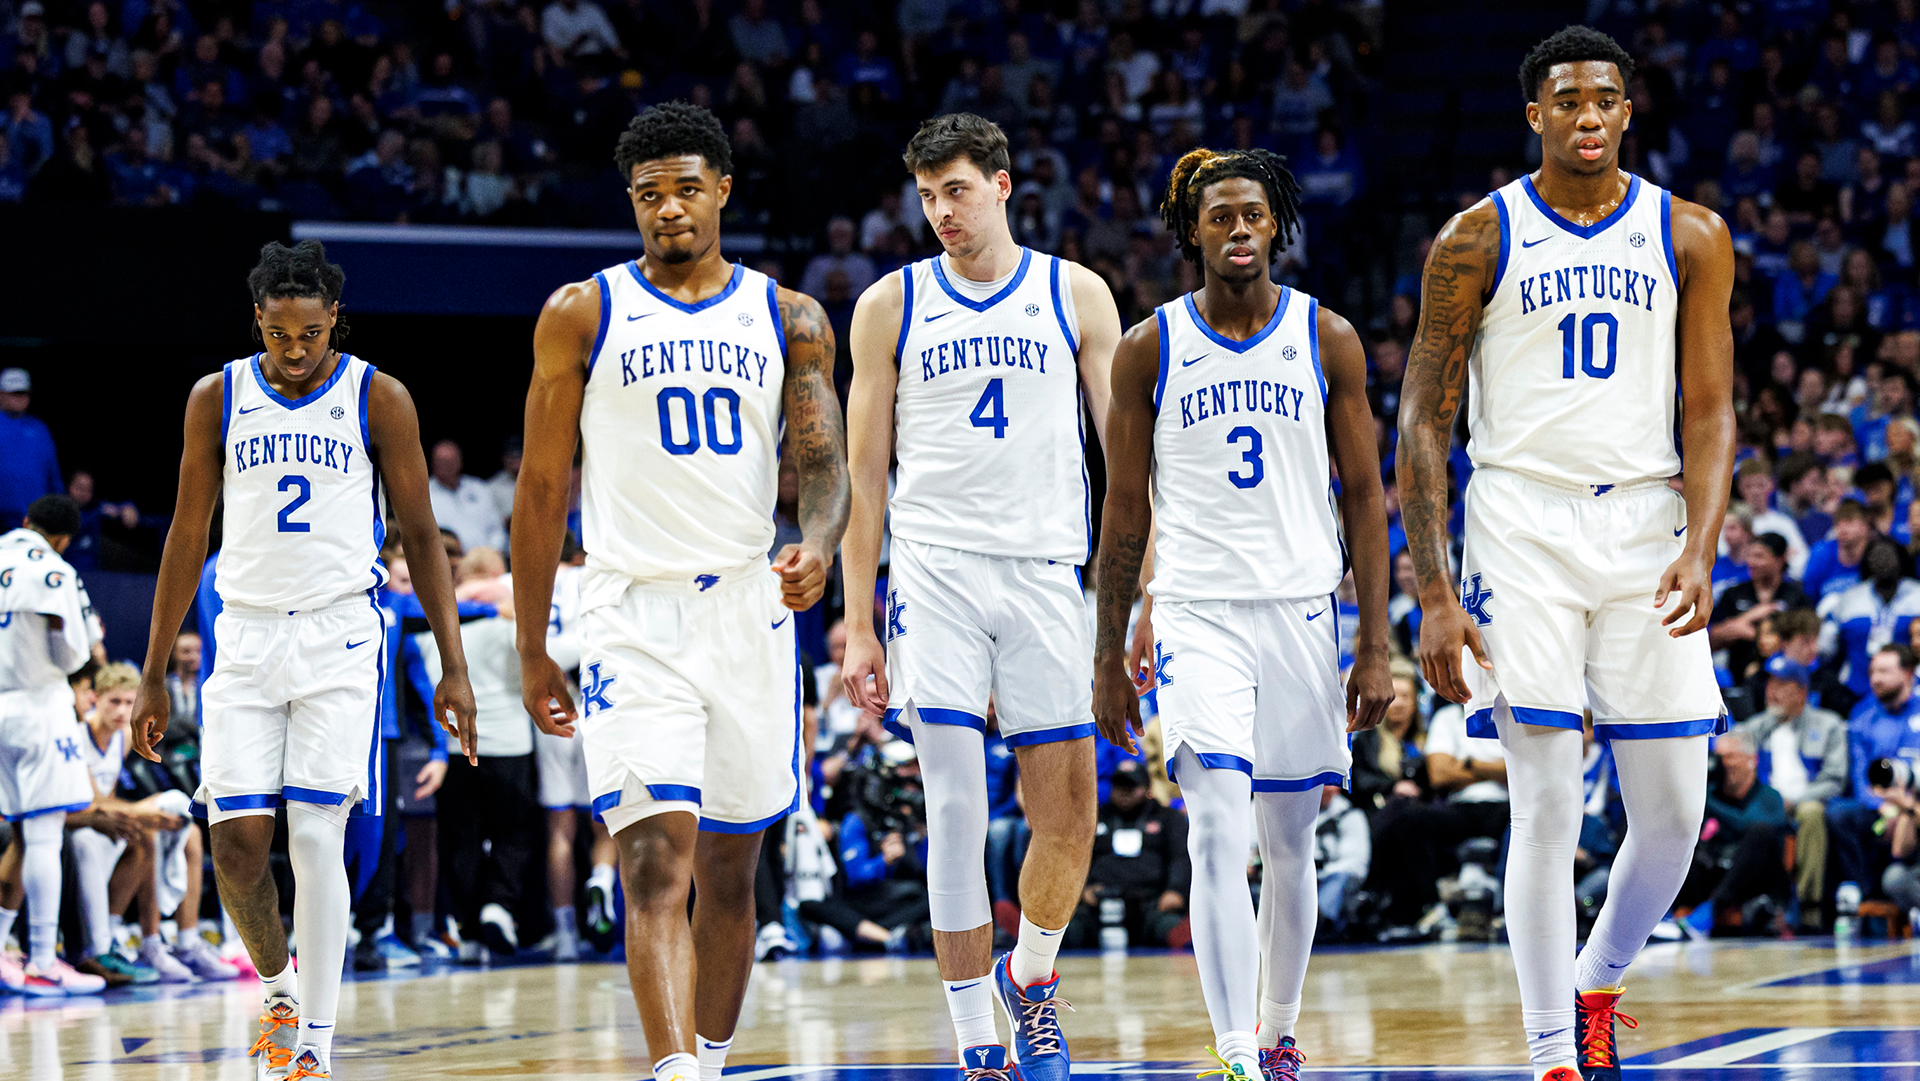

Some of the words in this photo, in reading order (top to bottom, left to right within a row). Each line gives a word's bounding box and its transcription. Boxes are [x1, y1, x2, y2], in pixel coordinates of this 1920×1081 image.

[1630, 233, 1645, 247] SEC
[1025, 304, 1039, 316] SEC
[1520, 265, 1656, 315] KENTUCKY
[621, 340, 767, 388] KENTUCKY
[921, 336, 1048, 382] KENTUCKY
[1282, 346, 1297, 360] SEC
[1558, 312, 1618, 379] 10
[331, 407, 344, 419] SEC
[656, 387, 743, 455] 00
[969, 378, 1009, 438] 4
[1180, 380, 1303, 430] KENTUCKY
[235, 433, 352, 473] KENTUCKY
[1227, 425, 1265, 489] 3
[278, 475, 311, 532] 2
